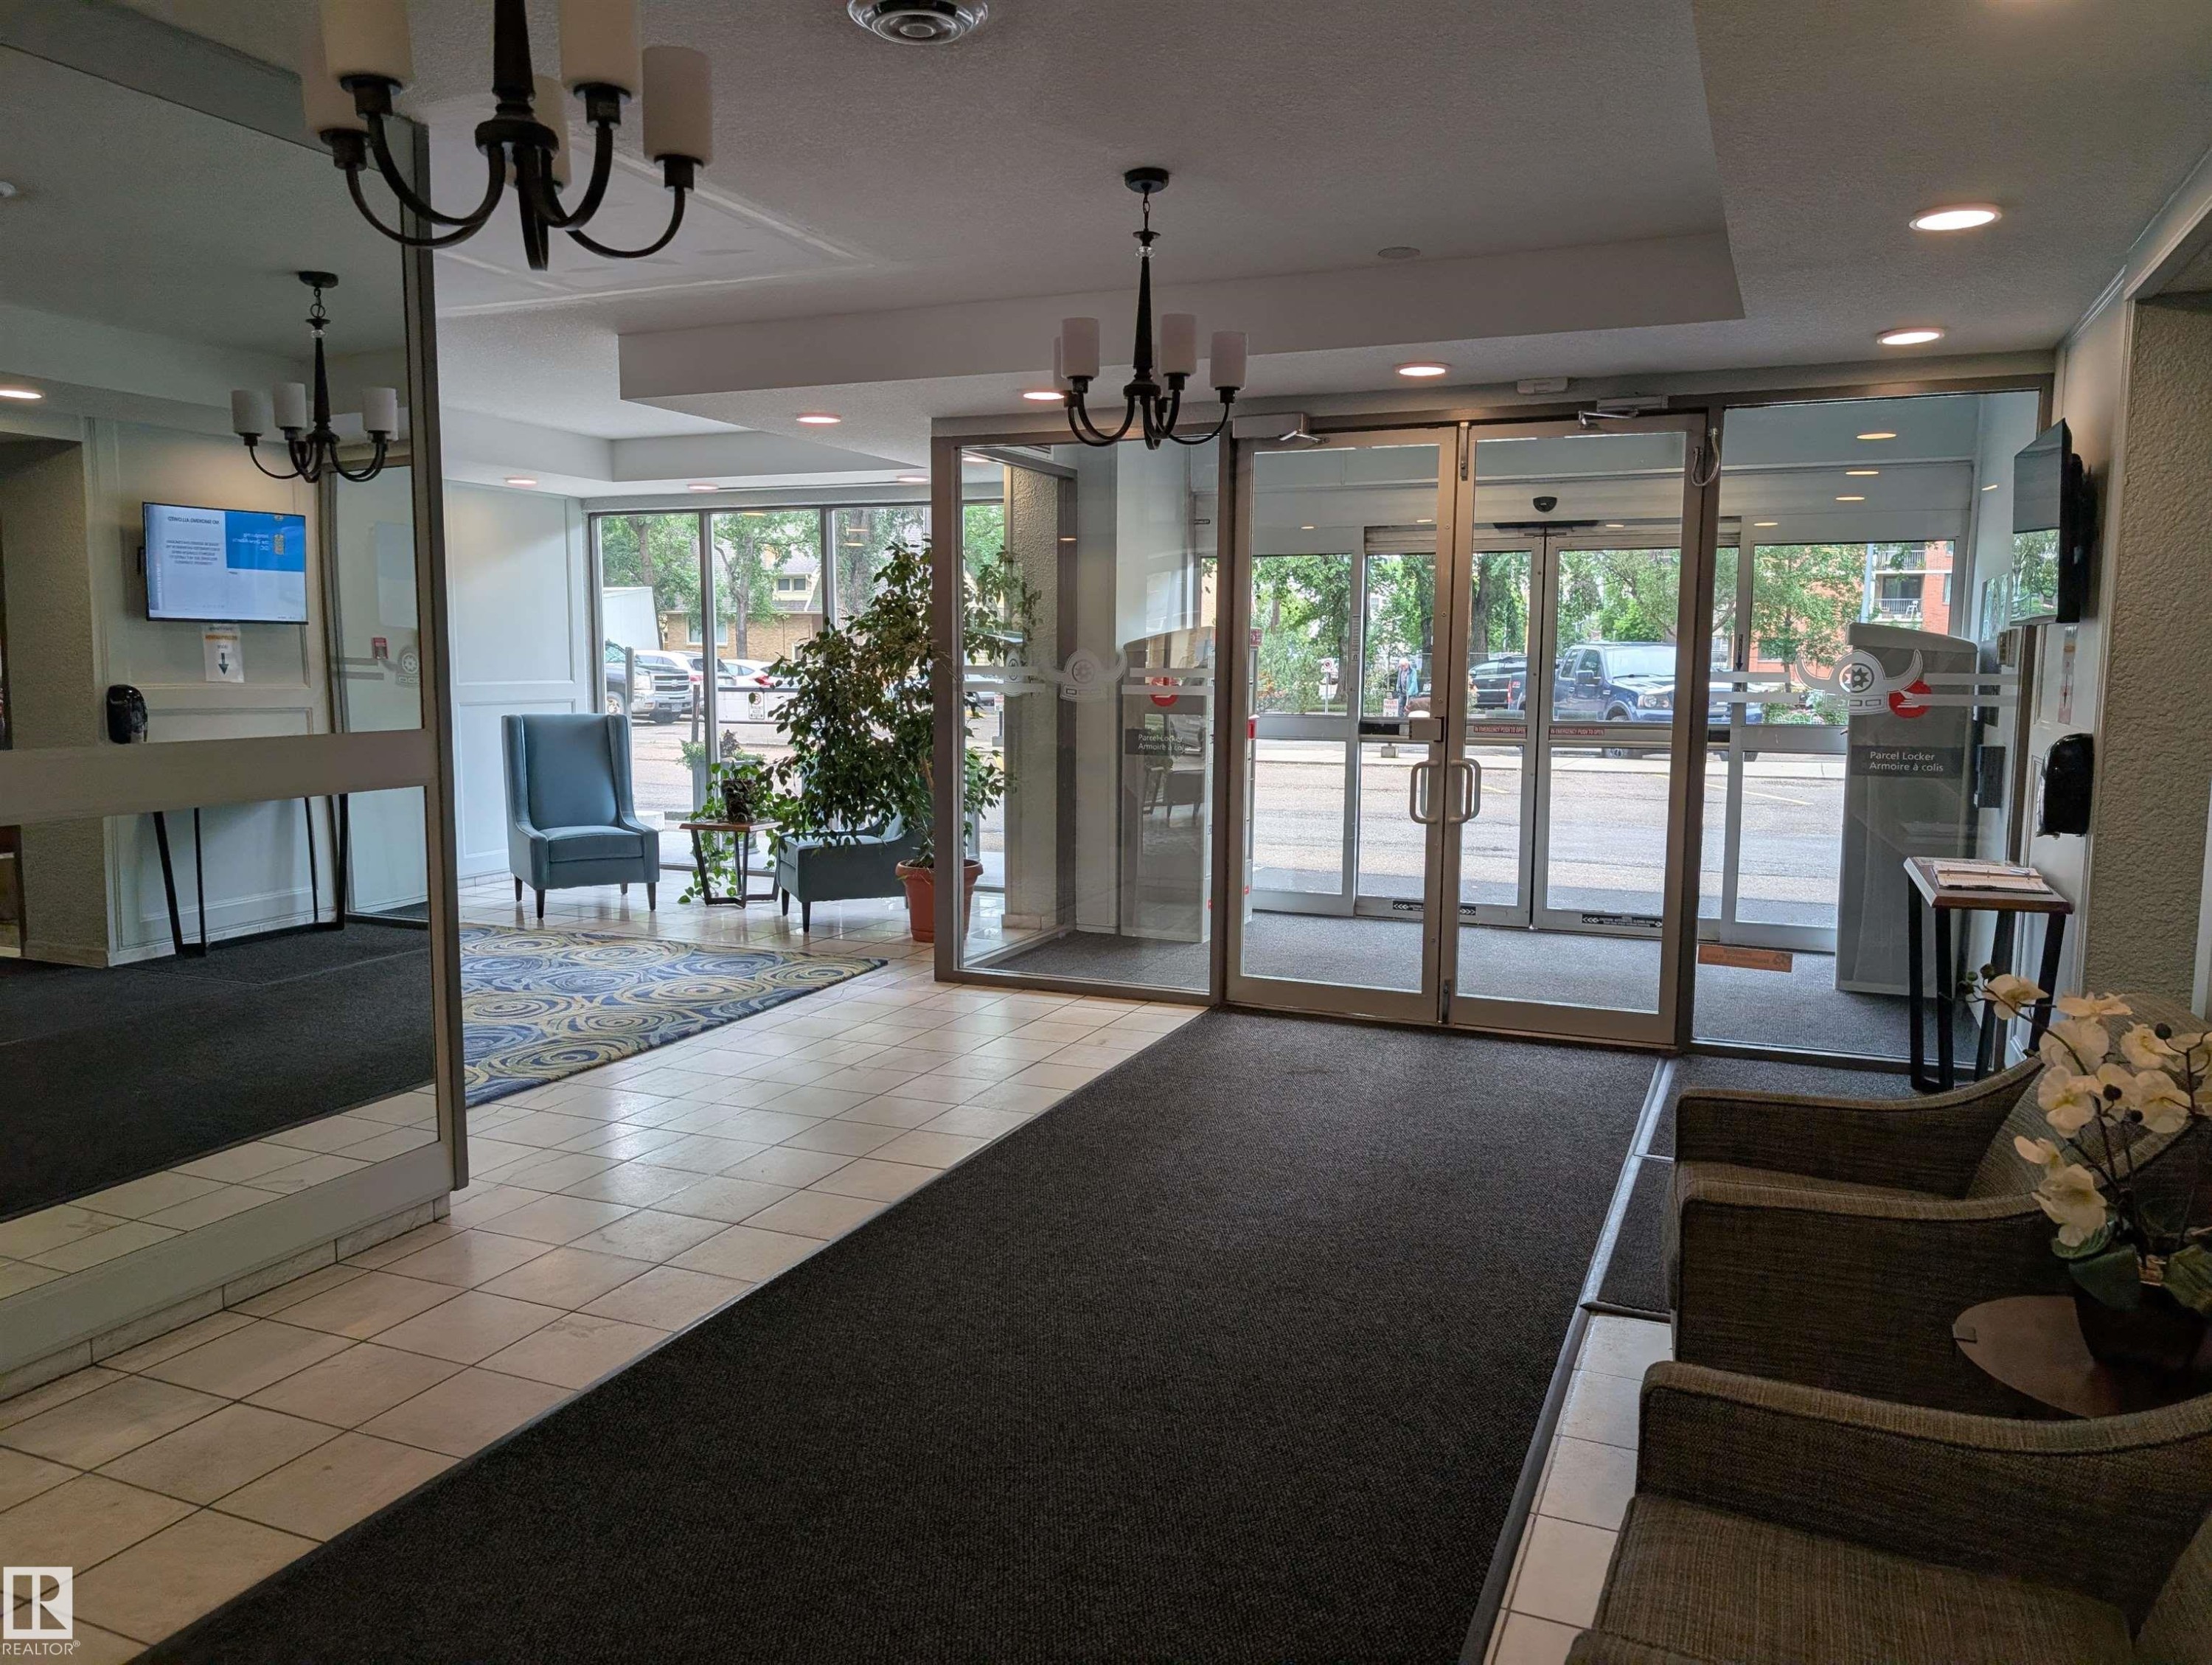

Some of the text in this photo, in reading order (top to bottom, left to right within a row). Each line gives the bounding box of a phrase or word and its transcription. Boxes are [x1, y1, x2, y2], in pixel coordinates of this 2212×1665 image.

[1870, 751, 1935, 761] Parcel Locker
[1869, 762, 1944, 772] Armoire à colis
